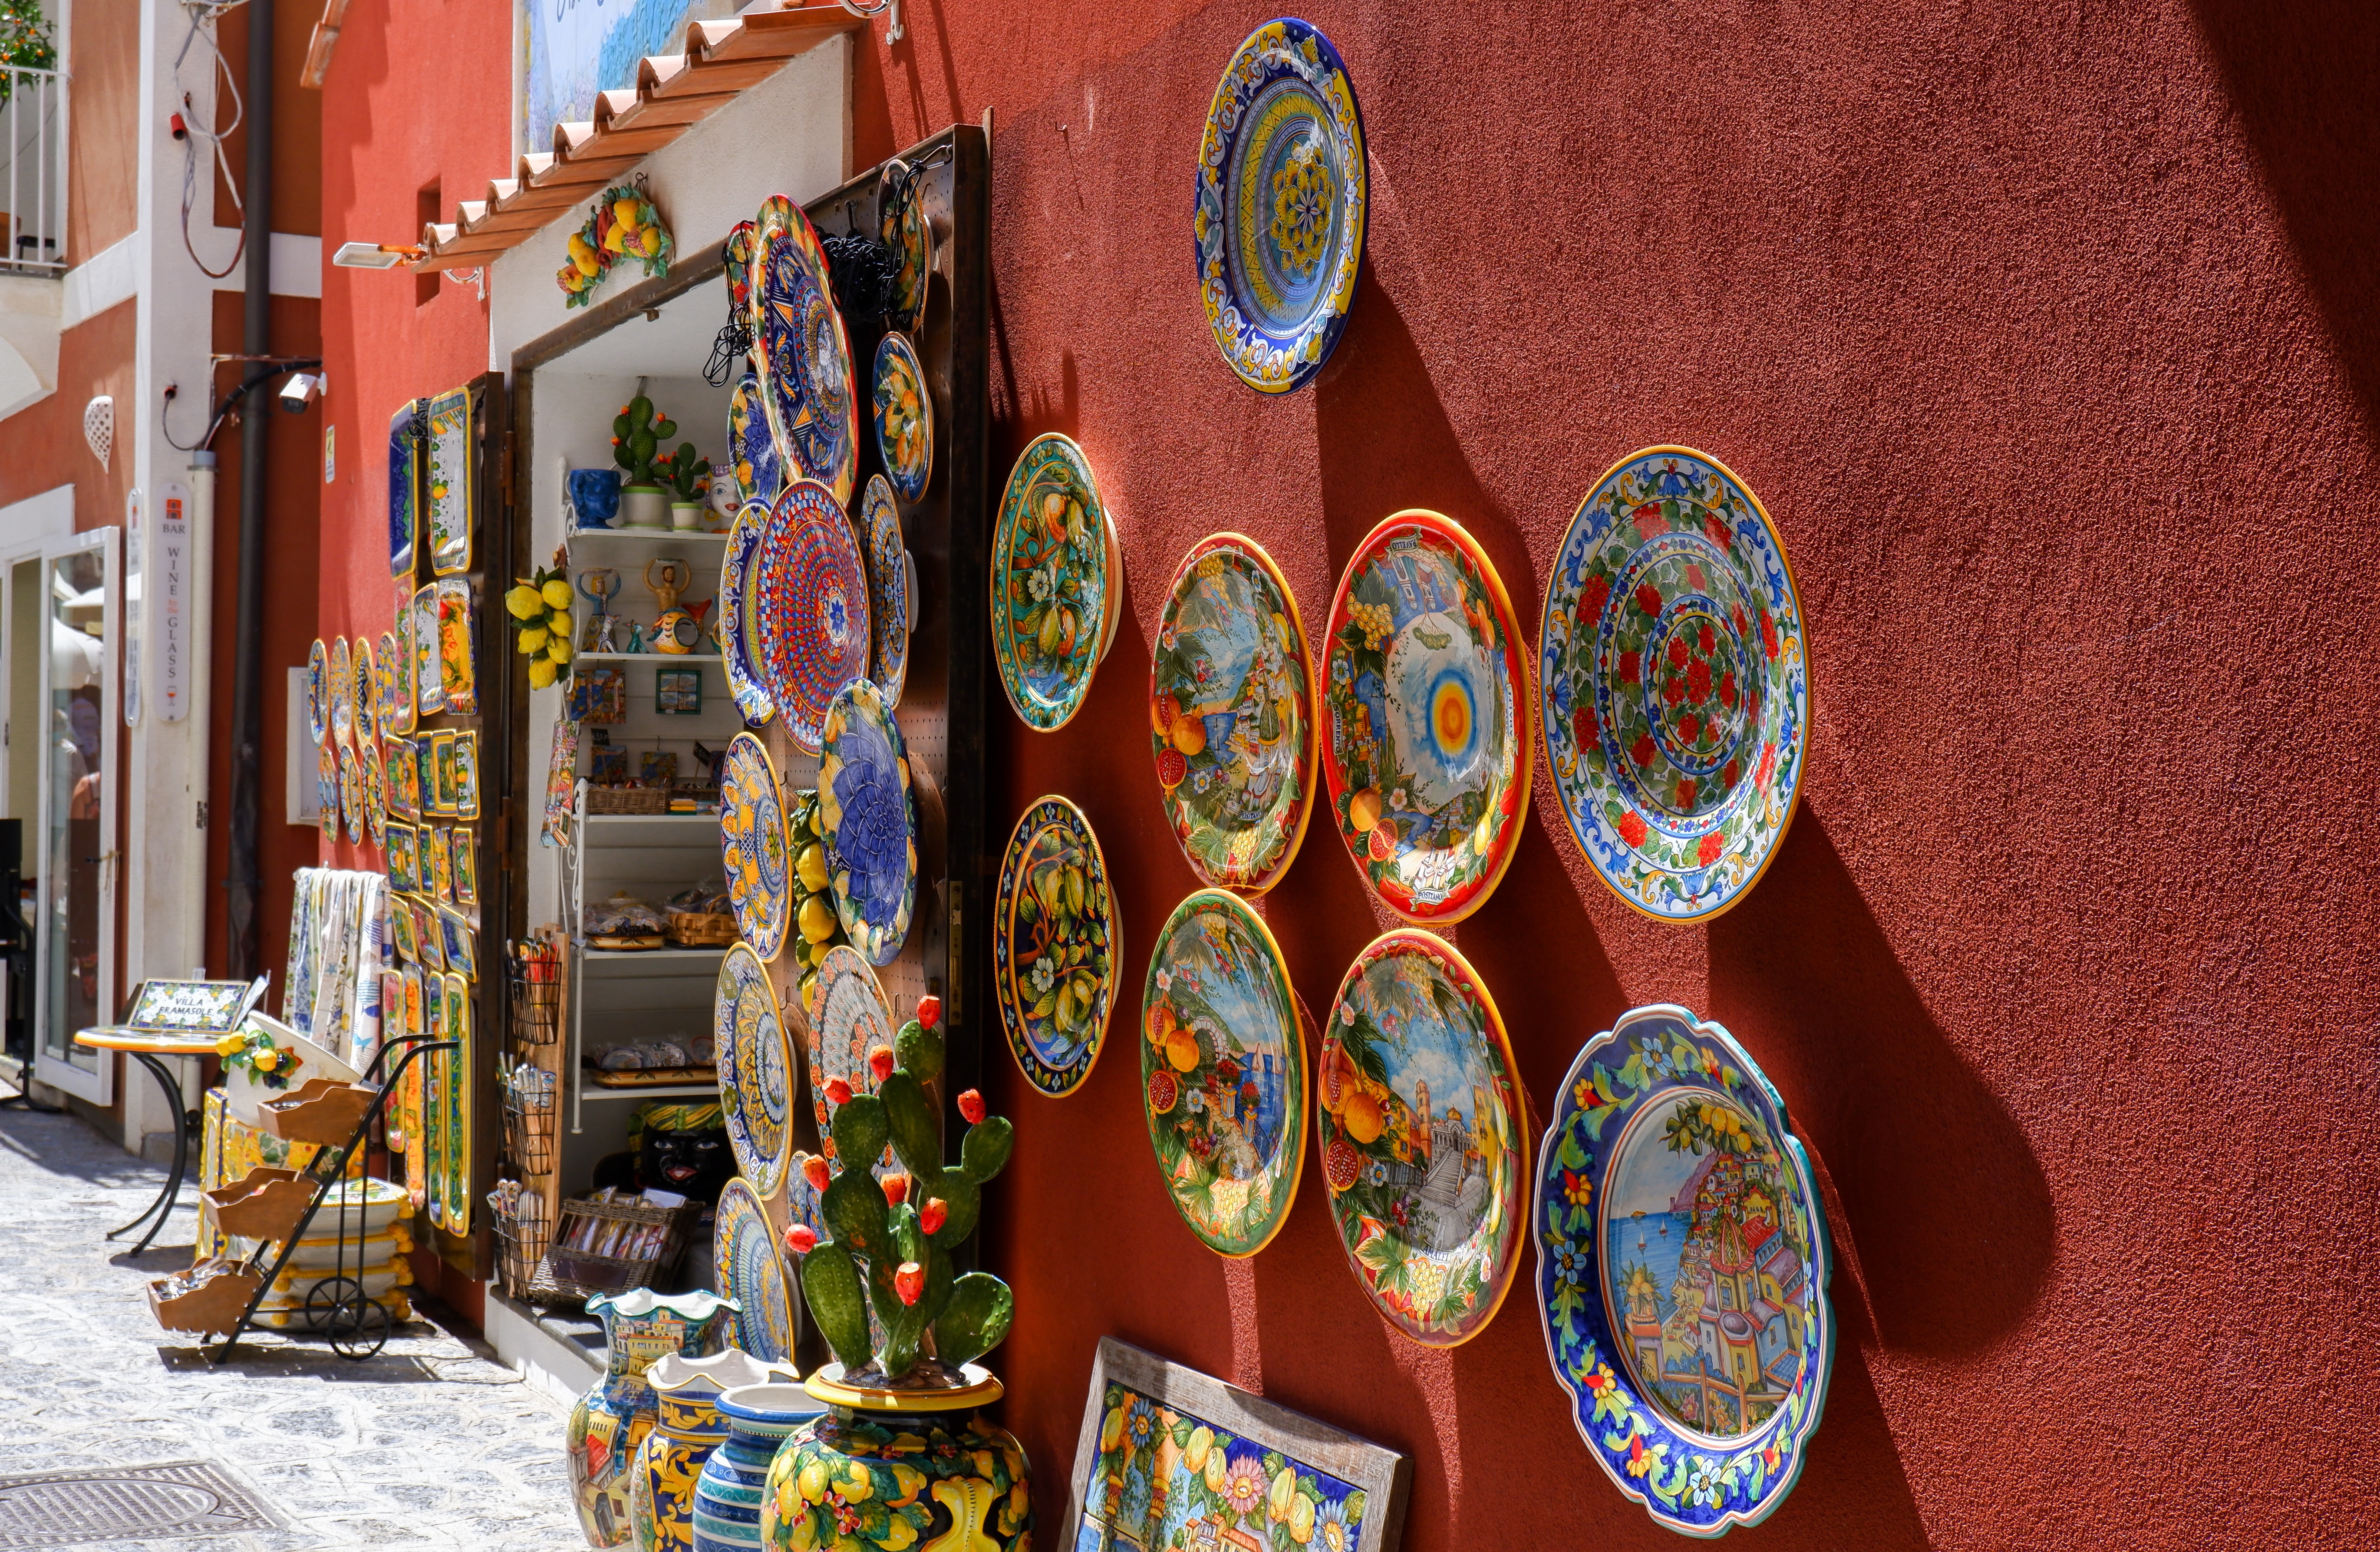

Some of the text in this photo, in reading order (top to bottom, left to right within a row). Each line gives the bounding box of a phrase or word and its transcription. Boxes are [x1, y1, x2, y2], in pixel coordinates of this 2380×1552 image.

[163, 524, 185, 534] BAR
[1392, 539, 1417, 549] RAVELLO
[168, 547, 180, 595] WINE
[168, 617, 178, 678] GLASS
[1333, 705, 1341, 753] SORRENTO
[1239, 811, 1263, 820] POSITANO
[1418, 891, 1442, 901] POSITANO
[176, 998, 203, 1006] VILLA
[158, 1006, 213, 1016] BRAMASOLE
